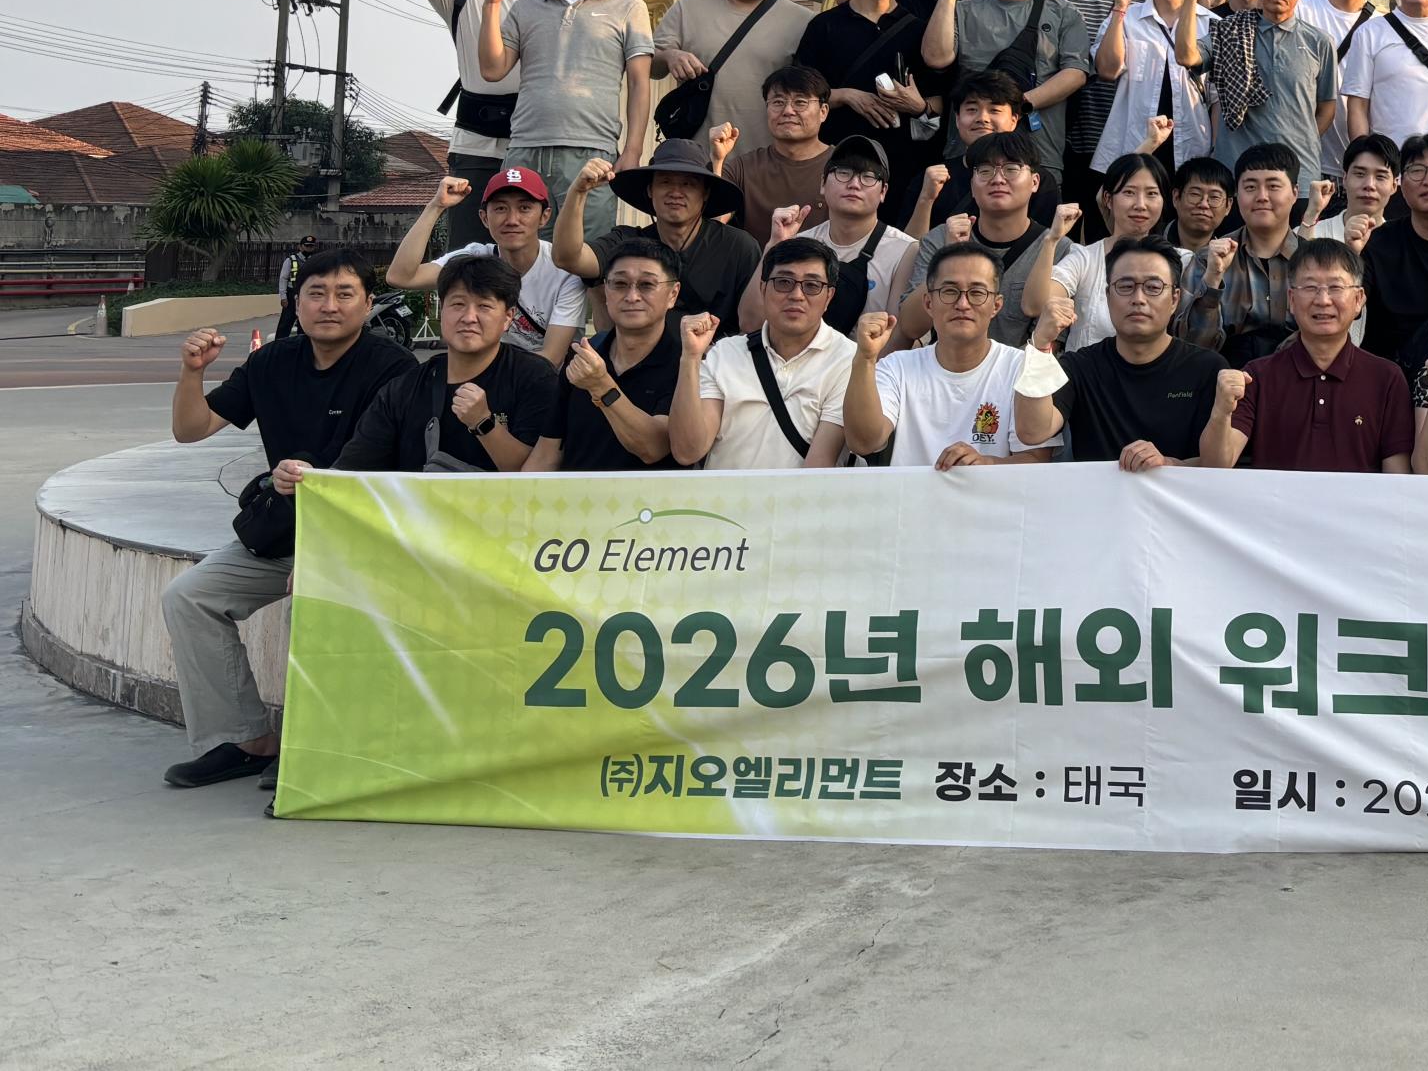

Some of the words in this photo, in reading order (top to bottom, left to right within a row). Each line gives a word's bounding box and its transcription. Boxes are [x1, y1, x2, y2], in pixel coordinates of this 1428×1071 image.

[534, 538, 590, 573] GO
[598, 538, 749, 572] Element
[524, 610, 922, 710] 2026년
[961, 608, 1173, 708] 해외
[1063, 765, 1147, 807] 태국
